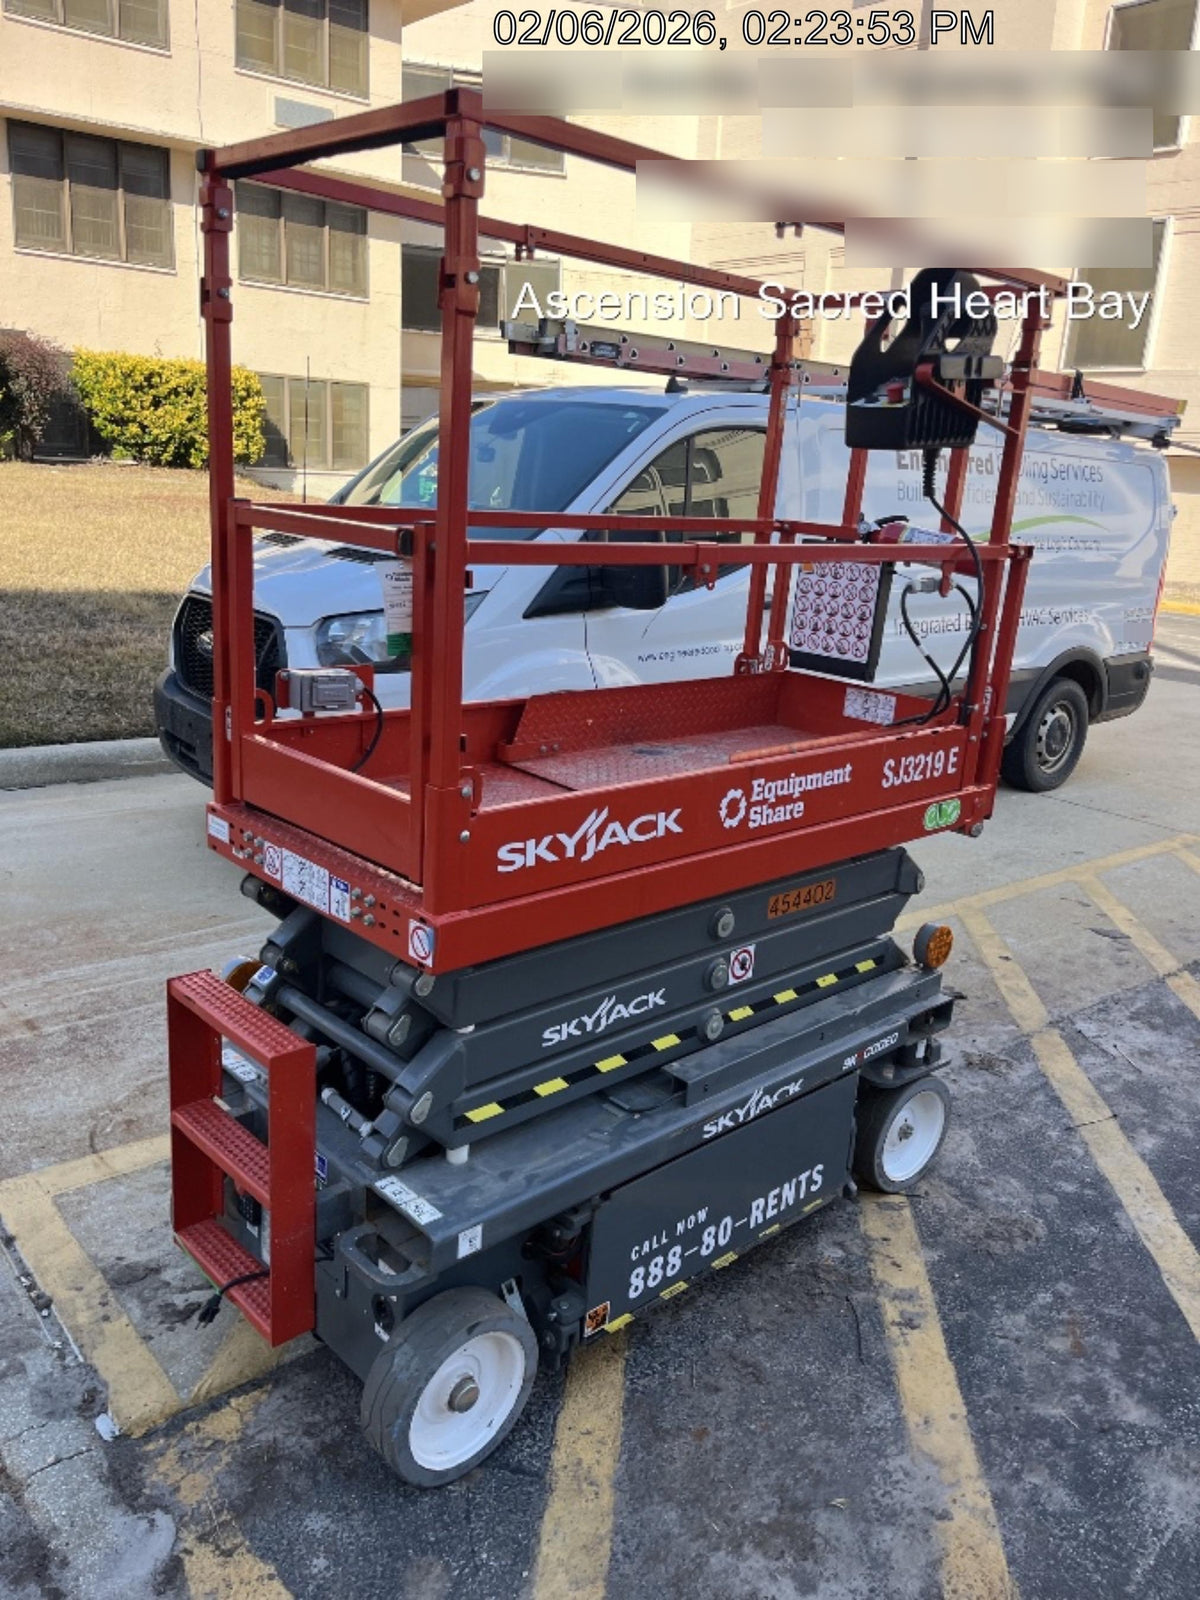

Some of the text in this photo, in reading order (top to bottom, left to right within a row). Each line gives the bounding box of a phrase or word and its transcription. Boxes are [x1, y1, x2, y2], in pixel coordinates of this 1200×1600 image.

[1050, 458, 1103, 482] Services
[751, 763, 852, 803] Equipment
[882, 746, 960, 788] SJ3219 E
[496, 806, 684, 872] SKYJACK
[749, 801, 804, 828] Share
[769, 881, 833, 916] 454402
[541, 987, 666, 1048] SKYJACK
[702, 1078, 804, 1139] SKYJACK
[628, 1163, 825, 1300] 888-80-RENTS
[630, 1206, 710, 1262] CALL NOW
